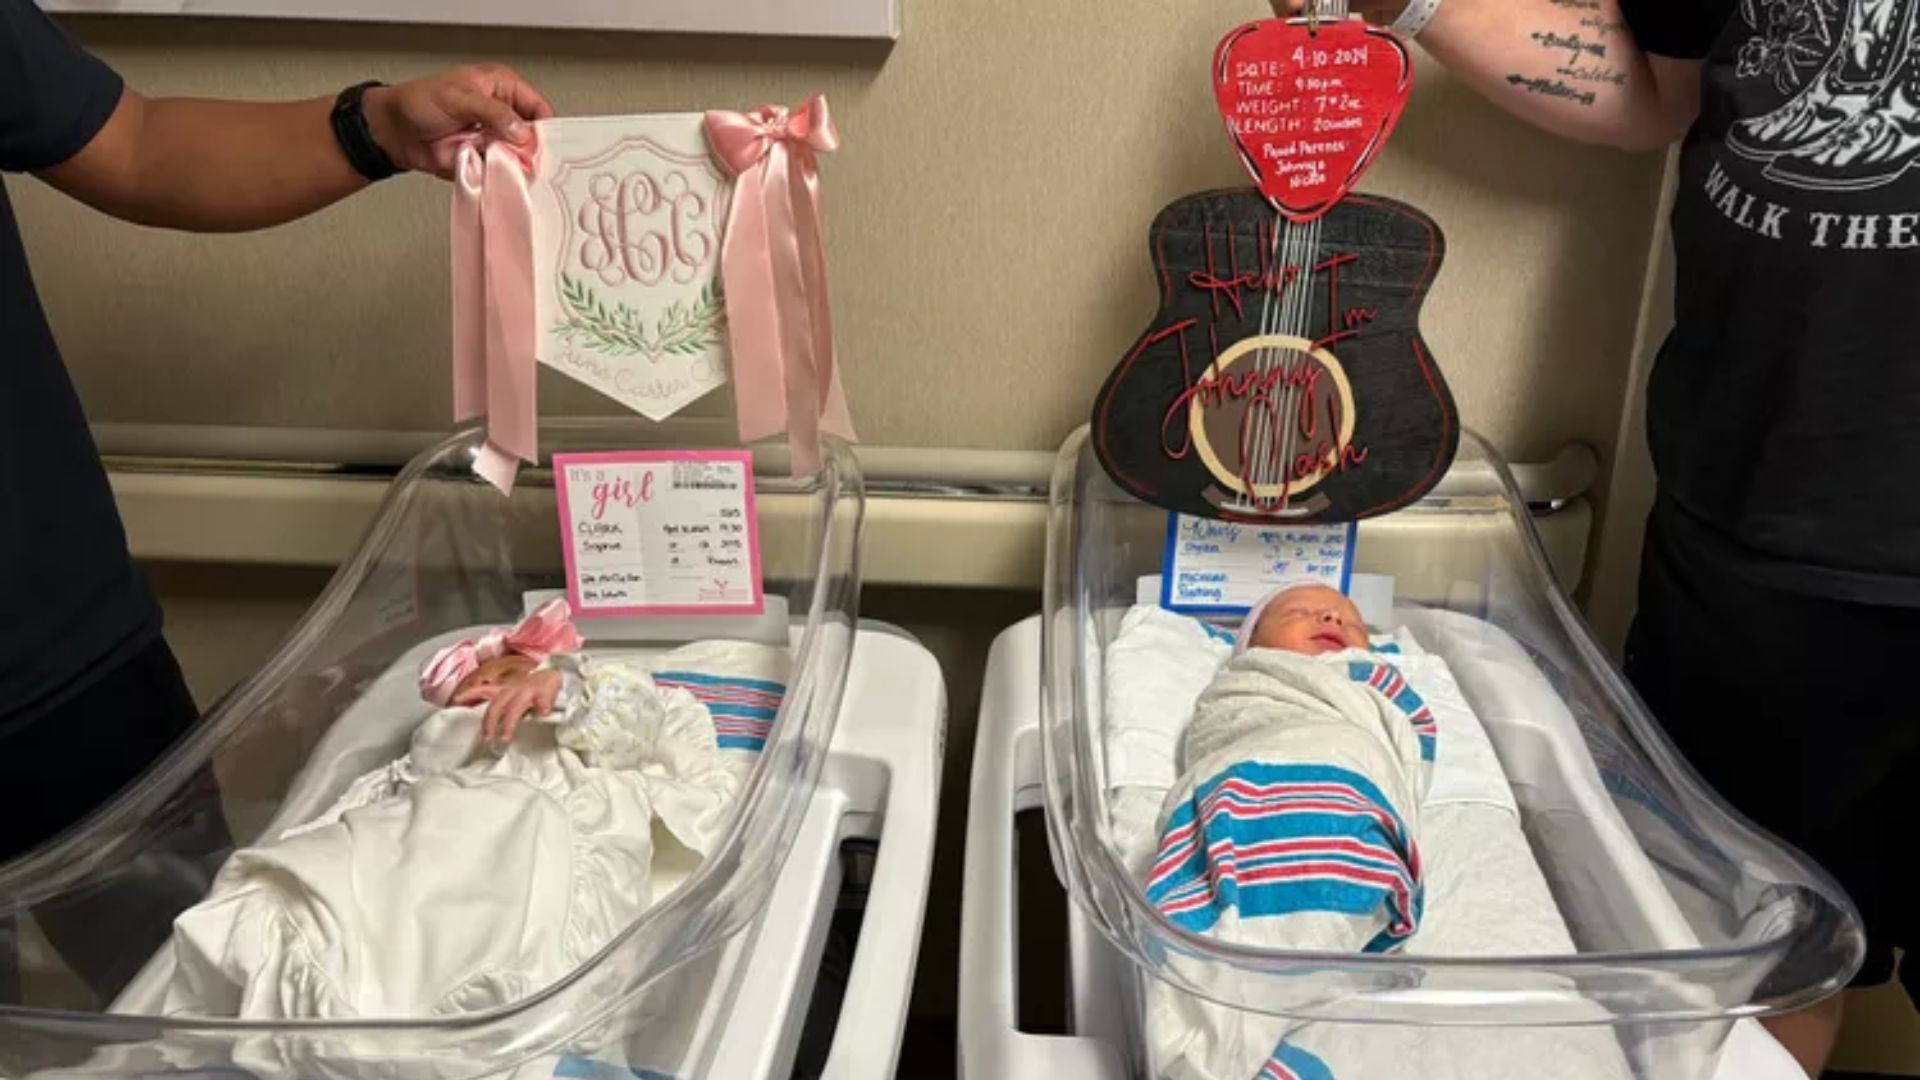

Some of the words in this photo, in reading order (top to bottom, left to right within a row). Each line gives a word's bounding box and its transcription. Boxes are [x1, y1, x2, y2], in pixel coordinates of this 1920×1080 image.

[1704, 159, 1791, 239] WALK
[1809, 211, 1920, 249] THE
[1187, 218, 1301, 321] Hello
[1148, 318, 1323, 460] Johnny
[591, 470, 654, 520] girl
[1239, 391, 1368, 513] Cash
